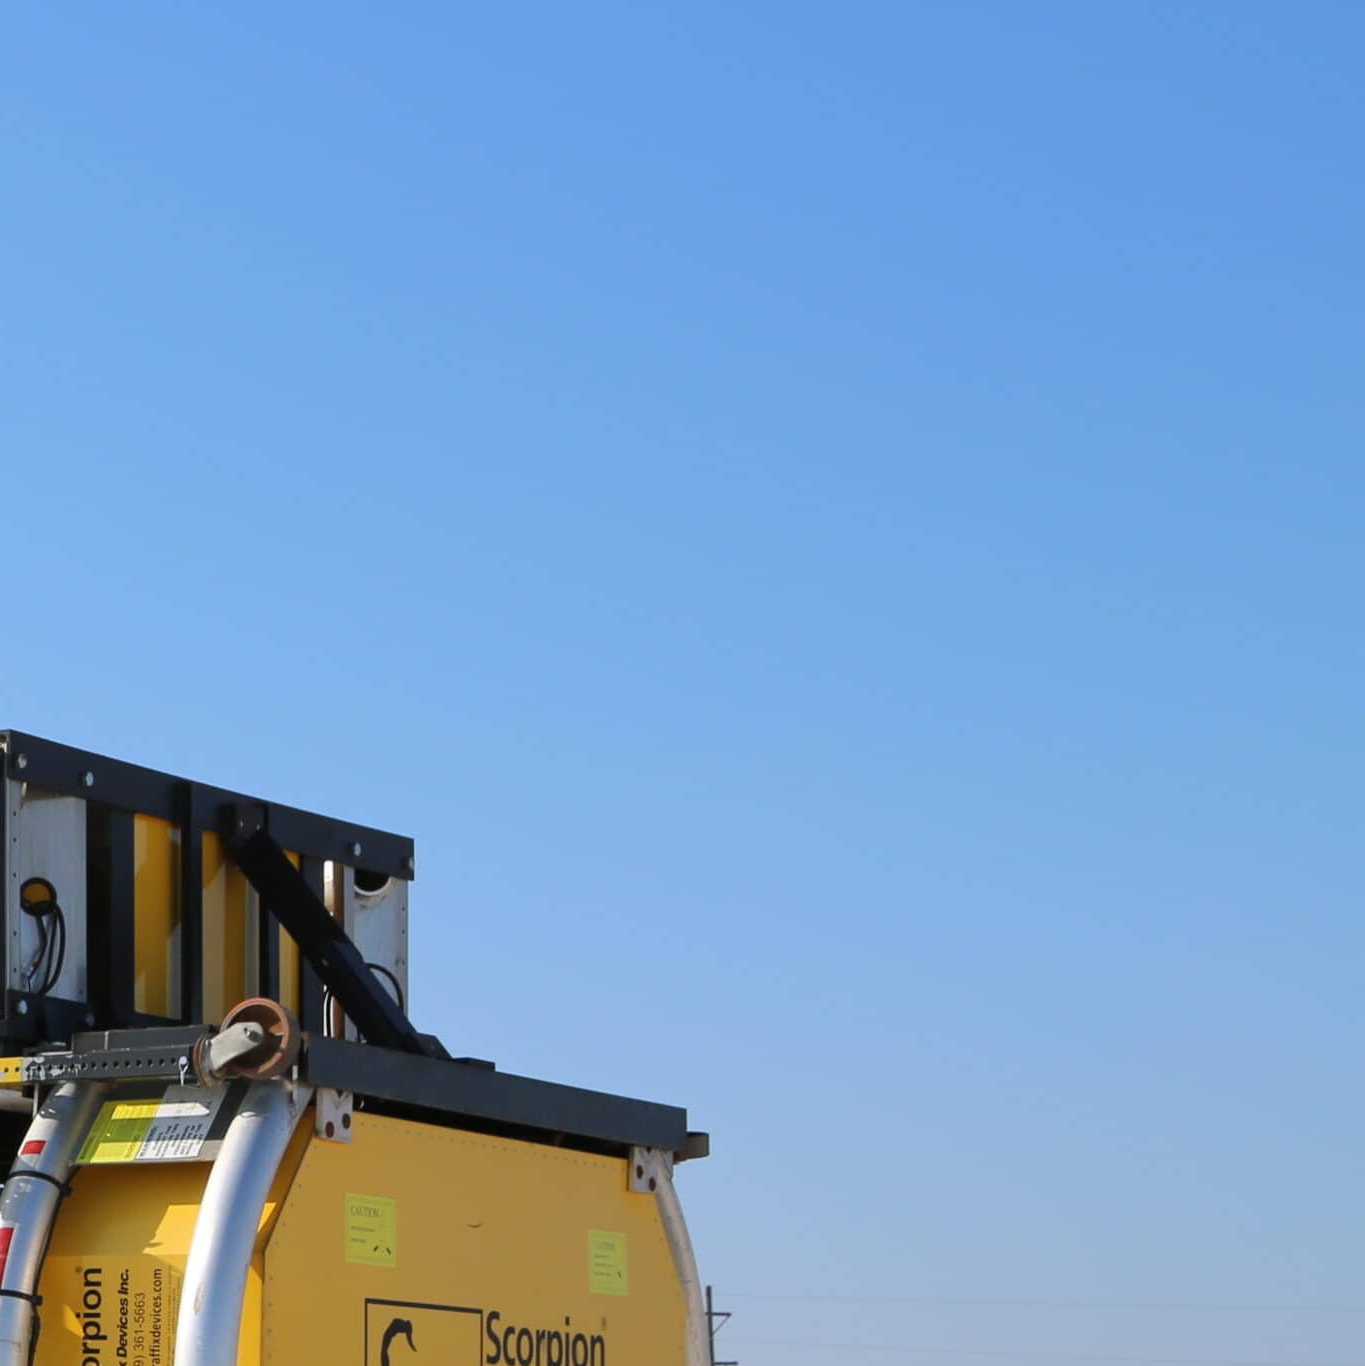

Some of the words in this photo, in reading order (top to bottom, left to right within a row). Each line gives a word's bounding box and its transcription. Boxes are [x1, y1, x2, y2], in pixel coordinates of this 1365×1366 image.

[117, 1269, 130, 1295] Inc.
[117, 1299, 129, 1358] Devices
[133, 1291, 146, 1351] 361-5663
